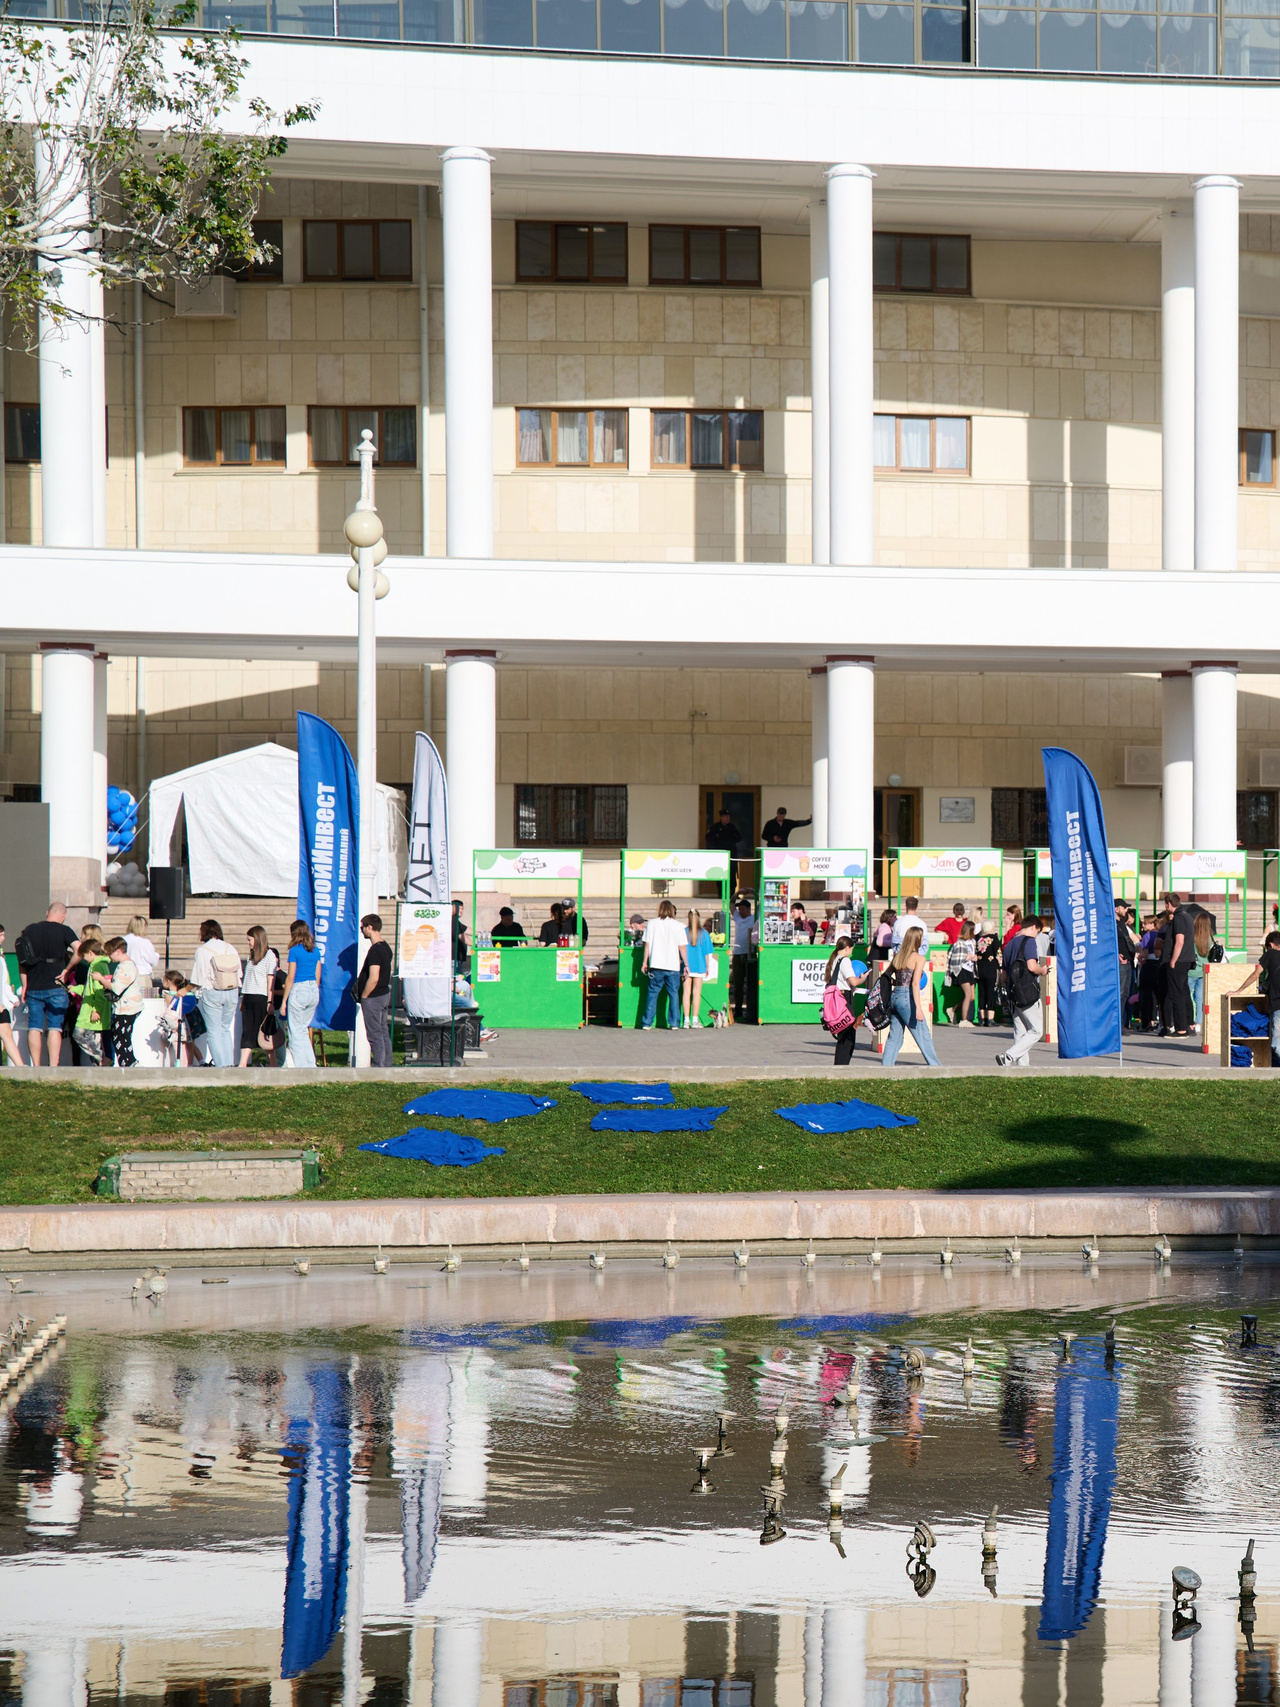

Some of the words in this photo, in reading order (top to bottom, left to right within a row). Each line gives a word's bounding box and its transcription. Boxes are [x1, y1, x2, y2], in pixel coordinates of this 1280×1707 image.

[339, 828, 349, 882] КОМПАНИЙ
[439, 840, 447, 894] КВАРТАЛ
[930, 856, 955, 868] Jam
[1085, 851, 1096, 905] КОМПАНИЙ
[336, 886, 346, 922] ГРУППА
[1090, 908, 1098, 944] ГРУППА
[799, 962, 826, 971] COFF
[803, 973, 825, 981] MOO
